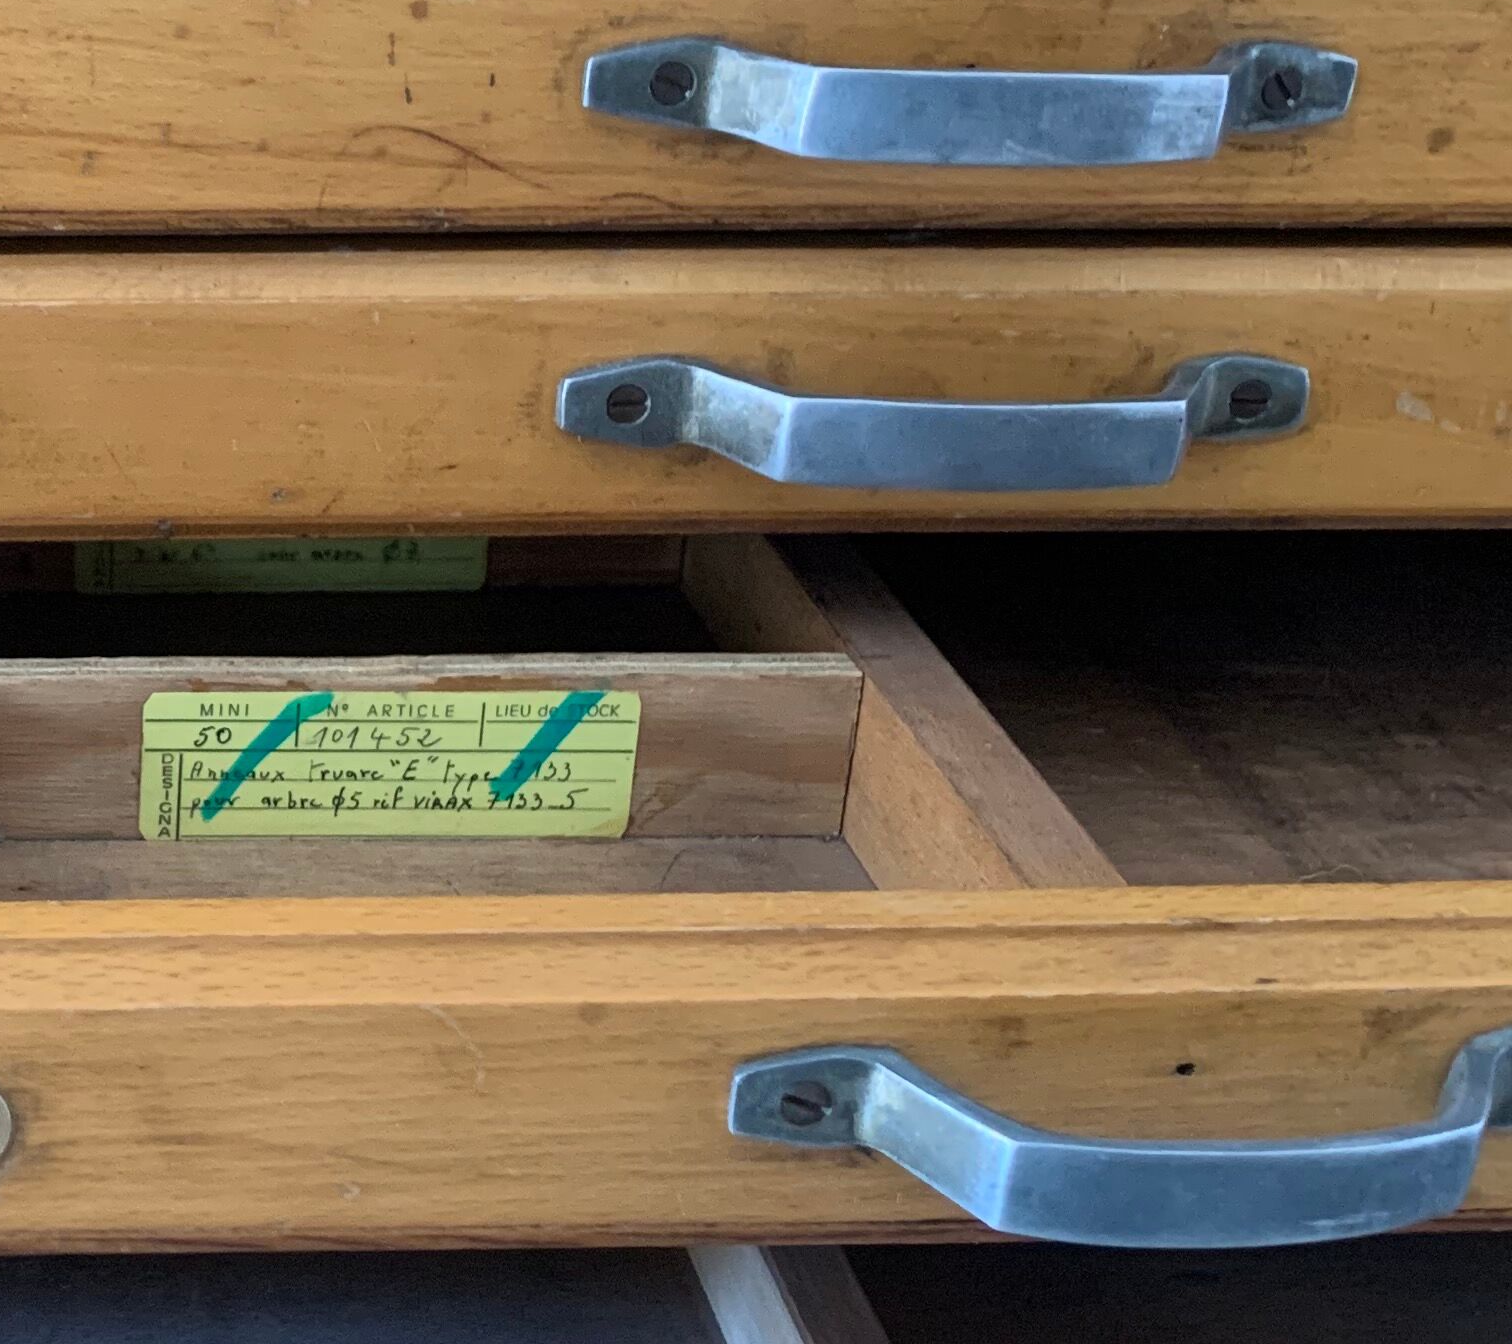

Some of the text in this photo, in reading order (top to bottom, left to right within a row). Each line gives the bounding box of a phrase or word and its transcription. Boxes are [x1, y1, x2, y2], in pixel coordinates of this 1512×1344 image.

[199, 703, 250, 717] MINI
[366, 703, 456, 718] ARTICLE
[495, 704, 532, 718] LIEU
[194, 725, 232, 748] 50
[157, 753, 175, 838] DESIGNA
[261, 790, 323, 810] arbre
